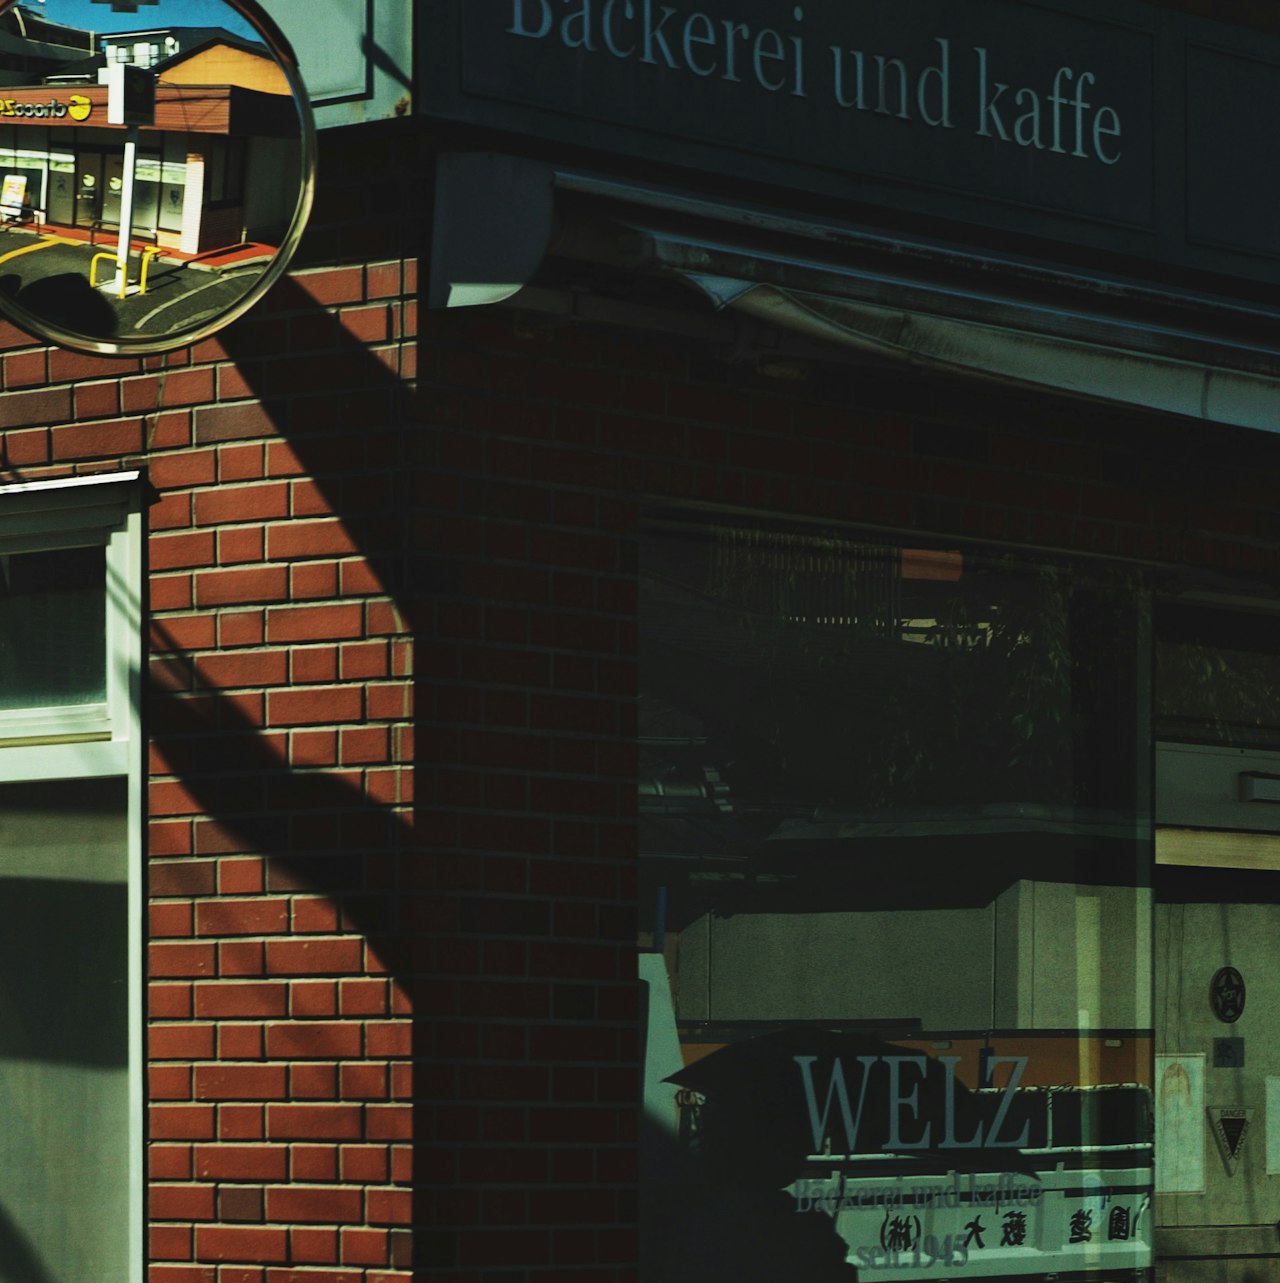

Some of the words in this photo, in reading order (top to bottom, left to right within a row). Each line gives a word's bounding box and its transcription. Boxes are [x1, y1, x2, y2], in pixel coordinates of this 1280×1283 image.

[828, 37, 956, 129] und
[972, 46, 1122, 166] kaffe
[792, 1055, 1031, 1152] WELZ
[1219, 1109, 1247, 1118] DANGER
